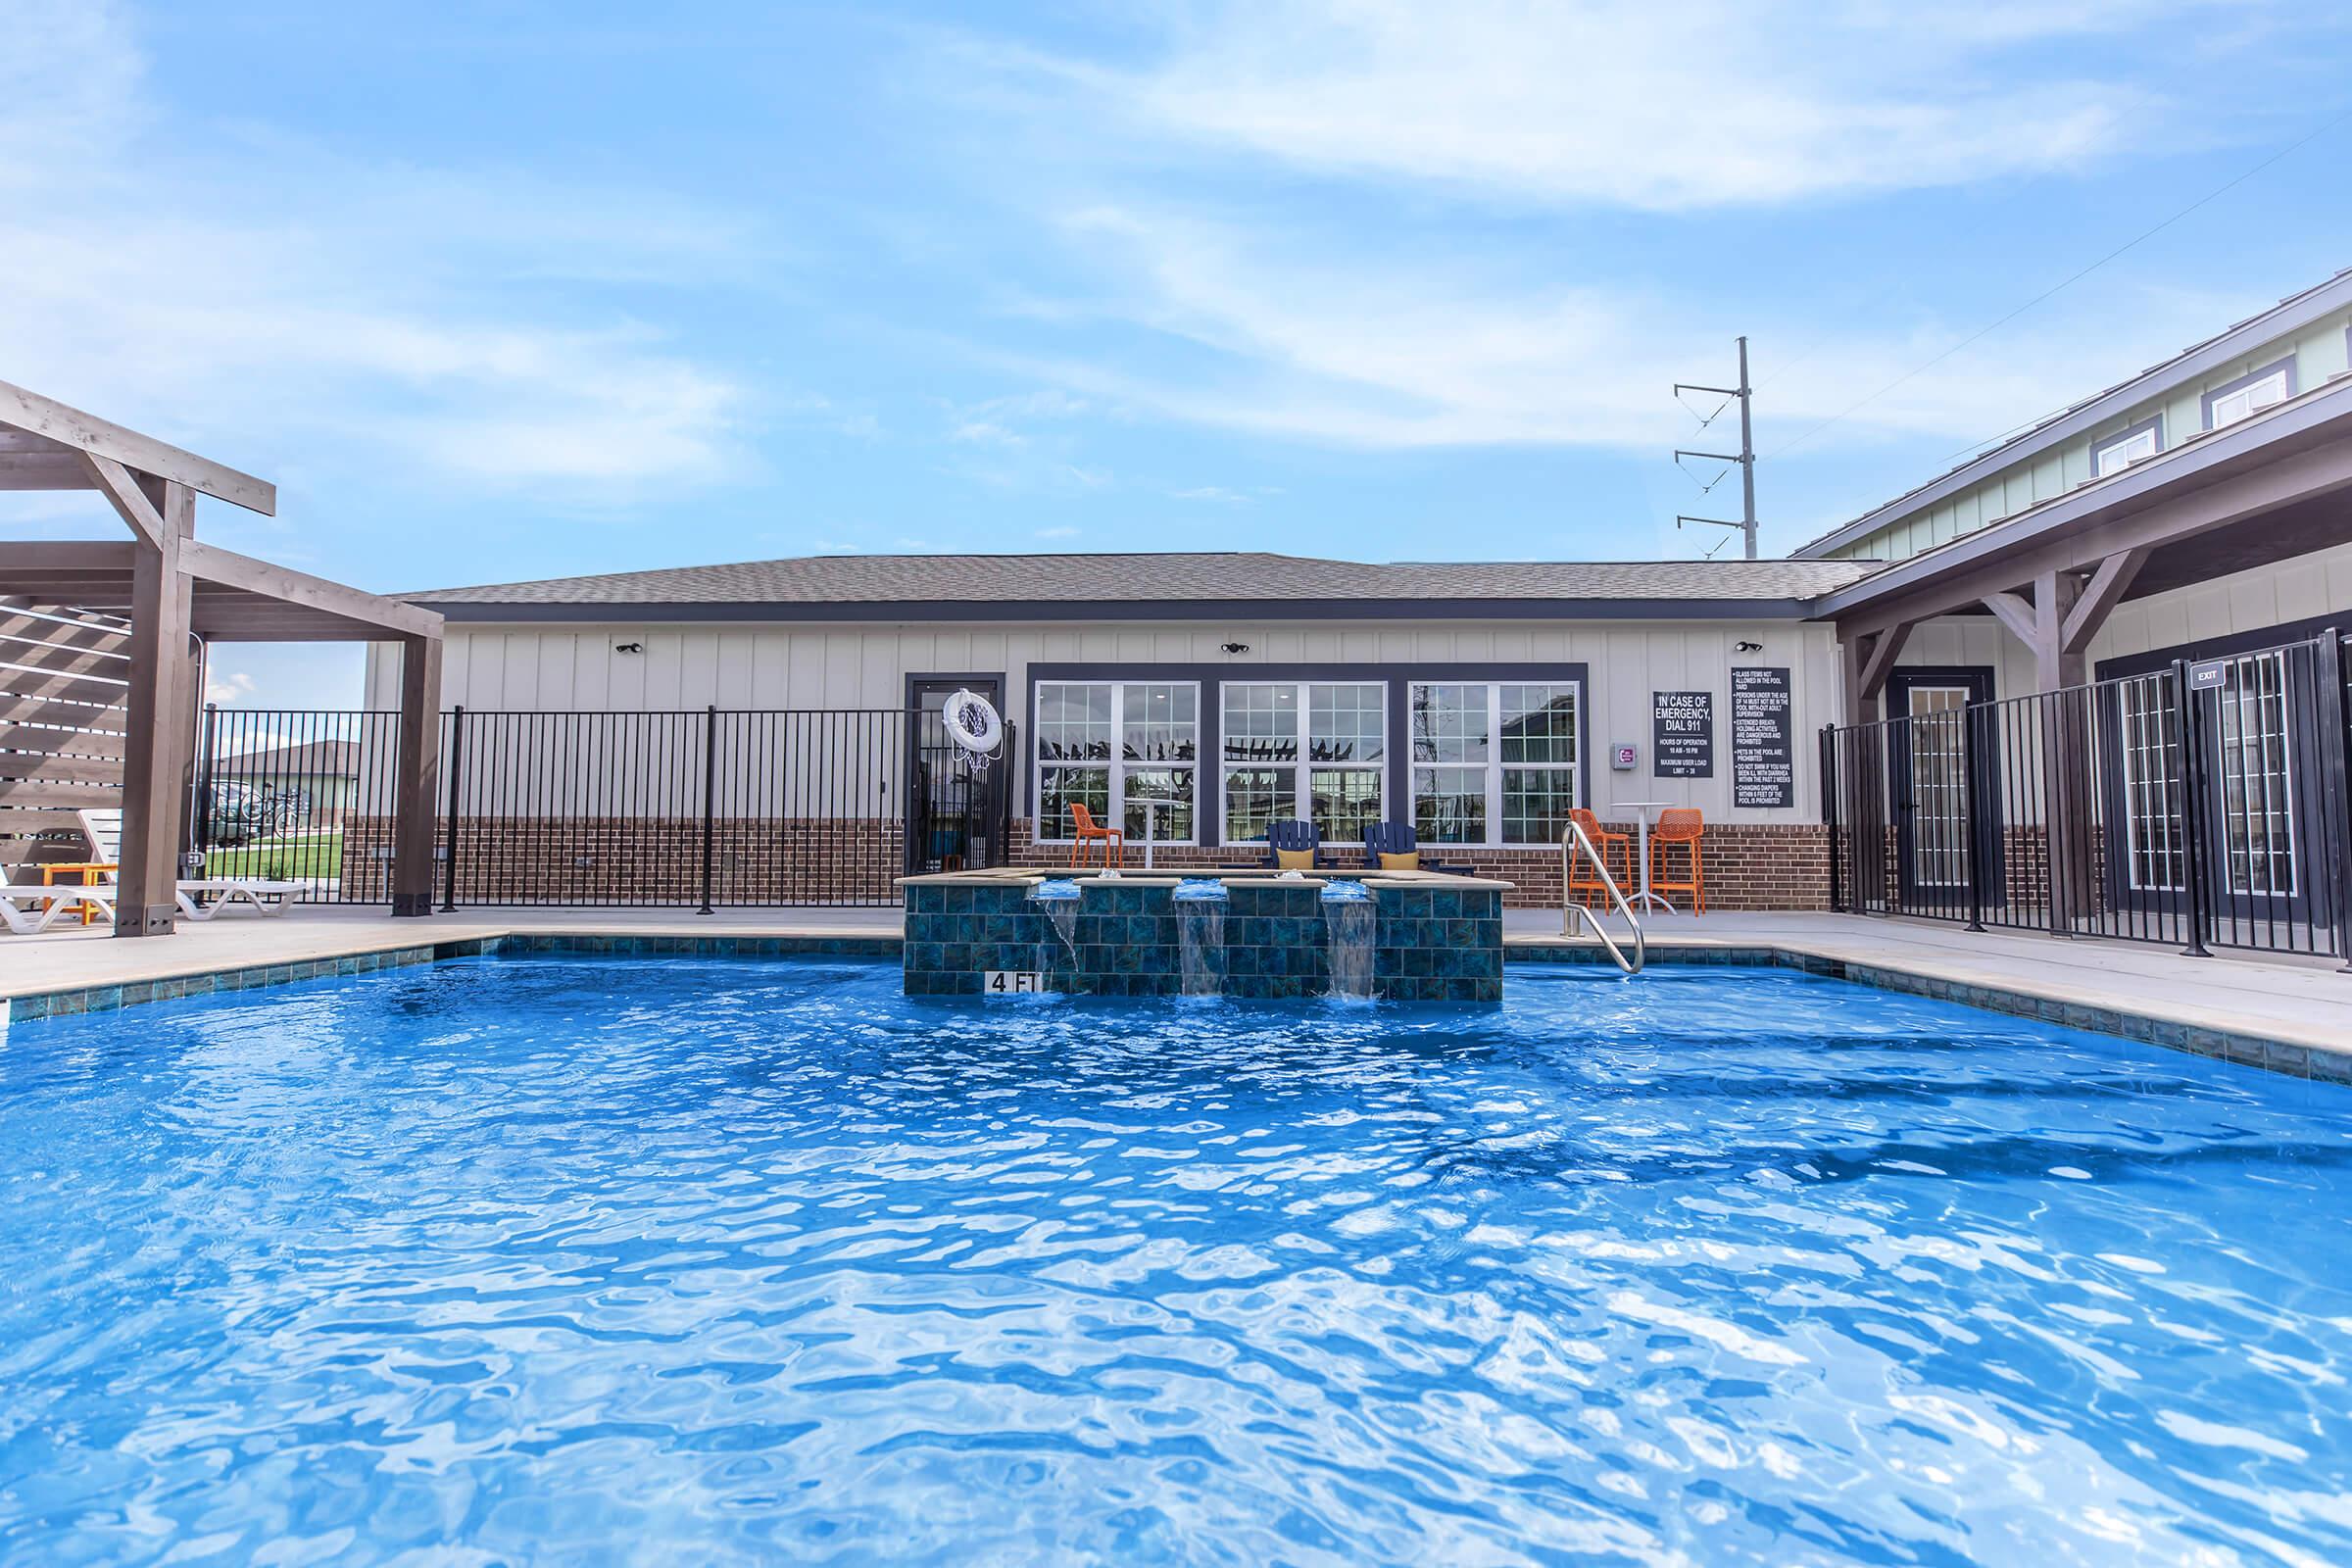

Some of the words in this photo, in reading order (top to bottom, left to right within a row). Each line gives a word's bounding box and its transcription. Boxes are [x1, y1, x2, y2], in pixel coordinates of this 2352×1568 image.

[2199, 670, 2217, 681] EXIT
[1658, 696, 1667, 707] IN
[1670, 696, 1693, 707] CASE
[1695, 696, 1707, 707] OF
[1656, 708, 1711, 721] EMERGENCY,
[1666, 720, 1686, 731] DIAL
[1687, 720, 1700, 731] 911
[992, 973, 1006, 992] 4
[1016, 973, 1039, 992] FT
